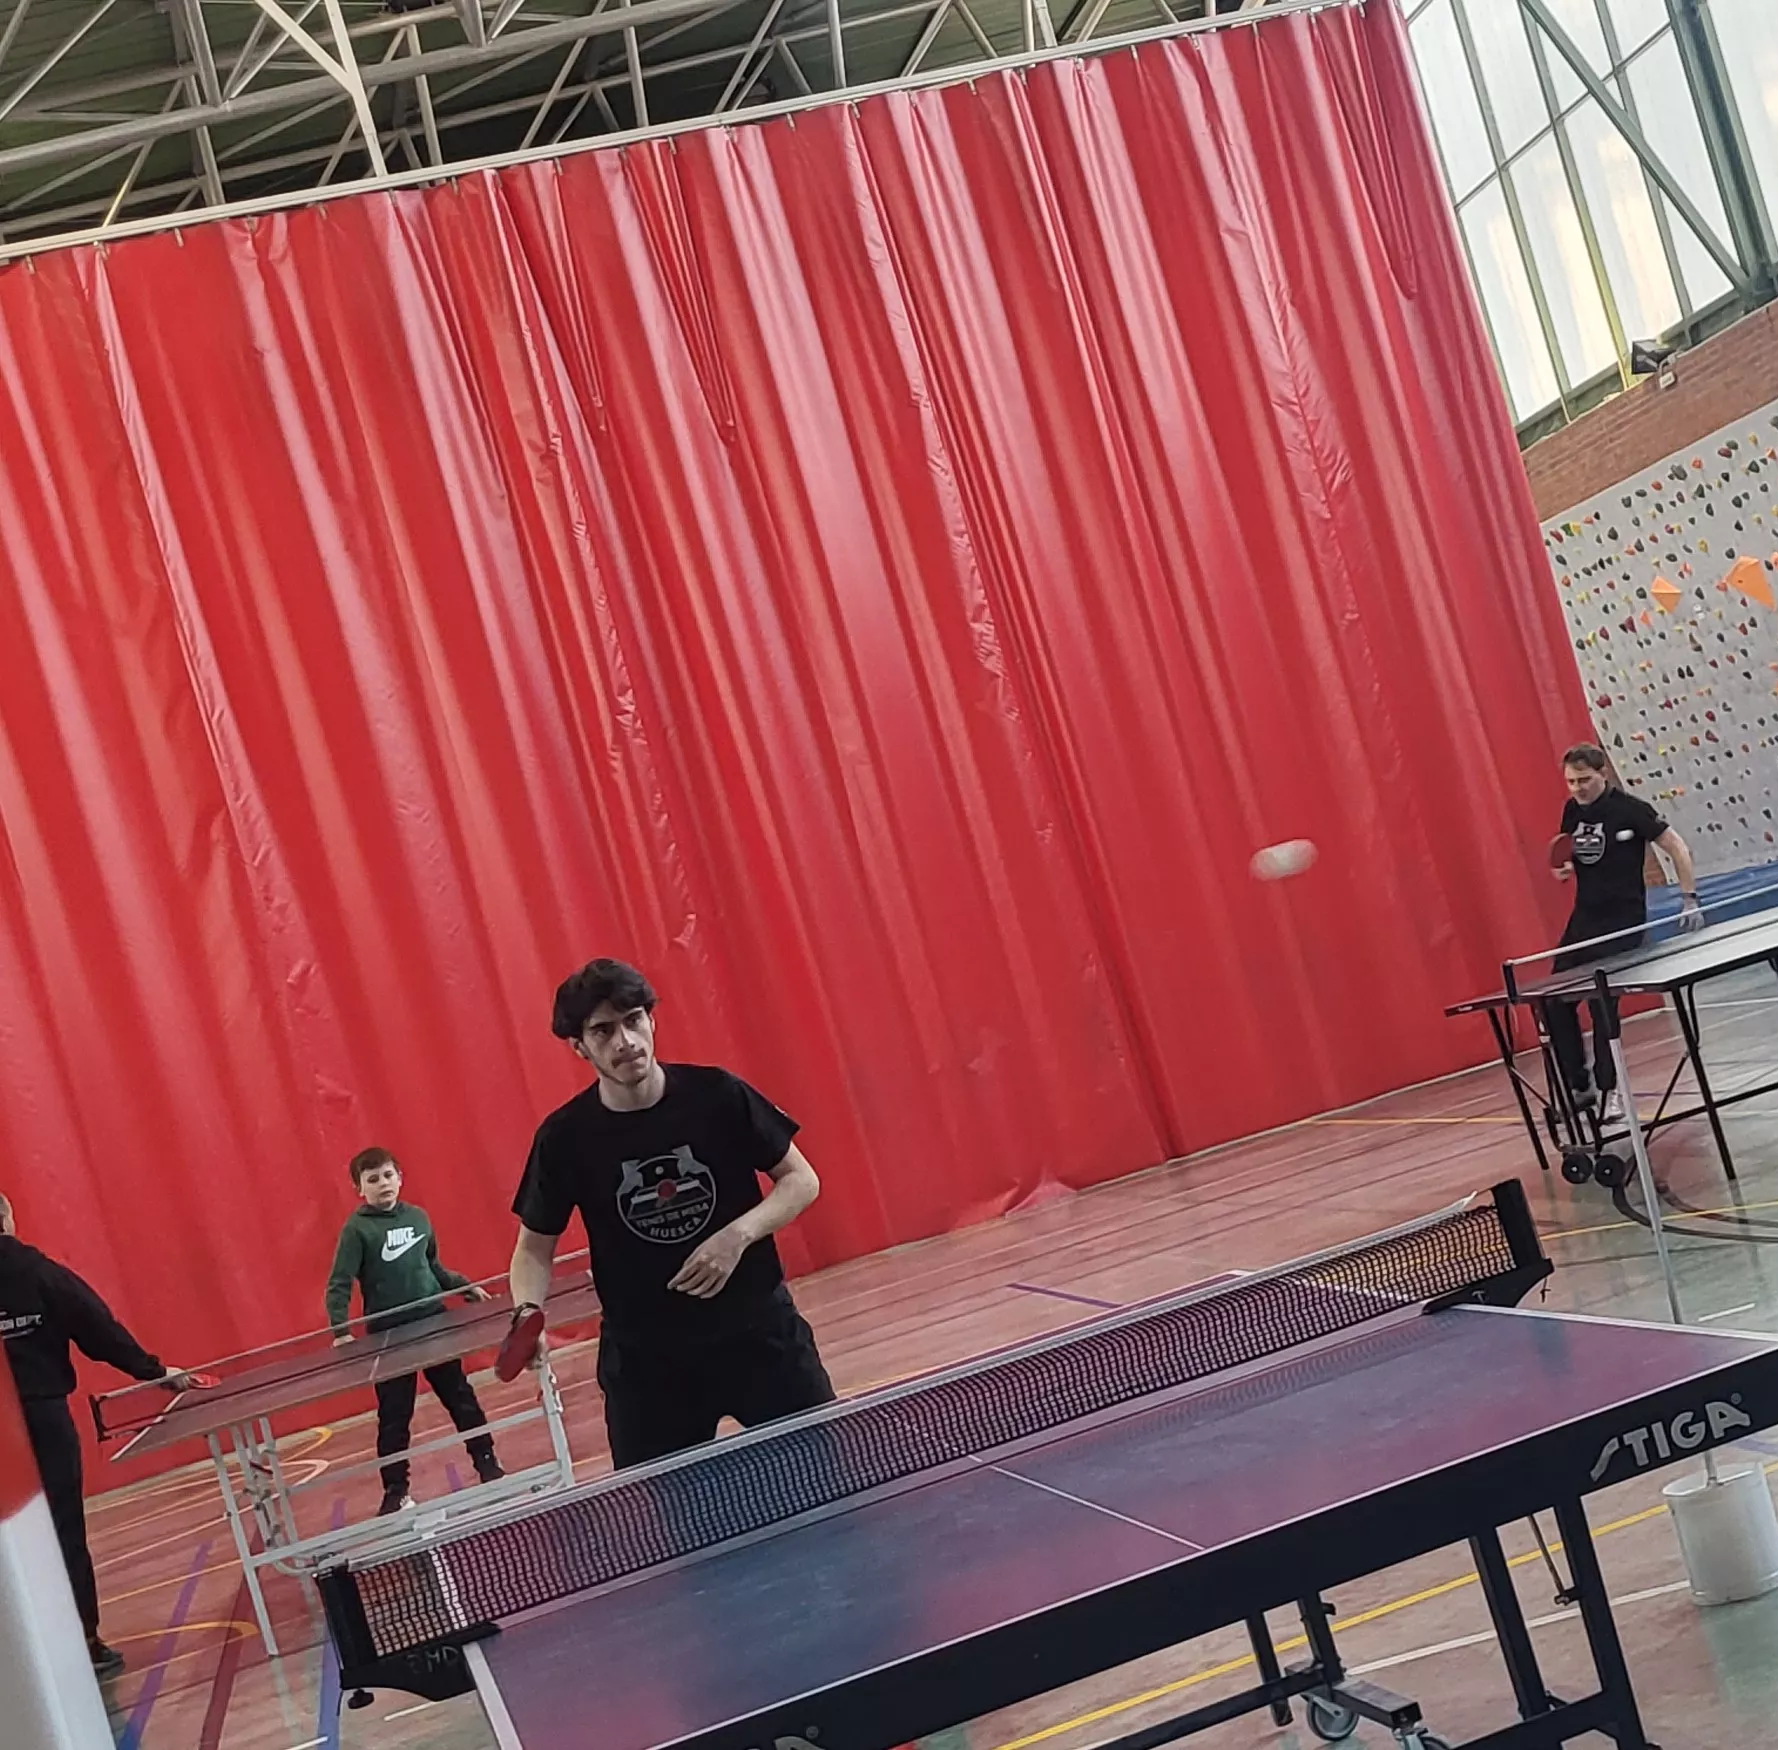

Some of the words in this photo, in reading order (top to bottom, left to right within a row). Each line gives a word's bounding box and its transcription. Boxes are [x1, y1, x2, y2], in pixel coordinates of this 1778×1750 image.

[387, 1226, 416, 1247] NIKE
[650, 1216, 702, 1238] HUESCA
[1590, 1400, 1751, 1482] STIGA
